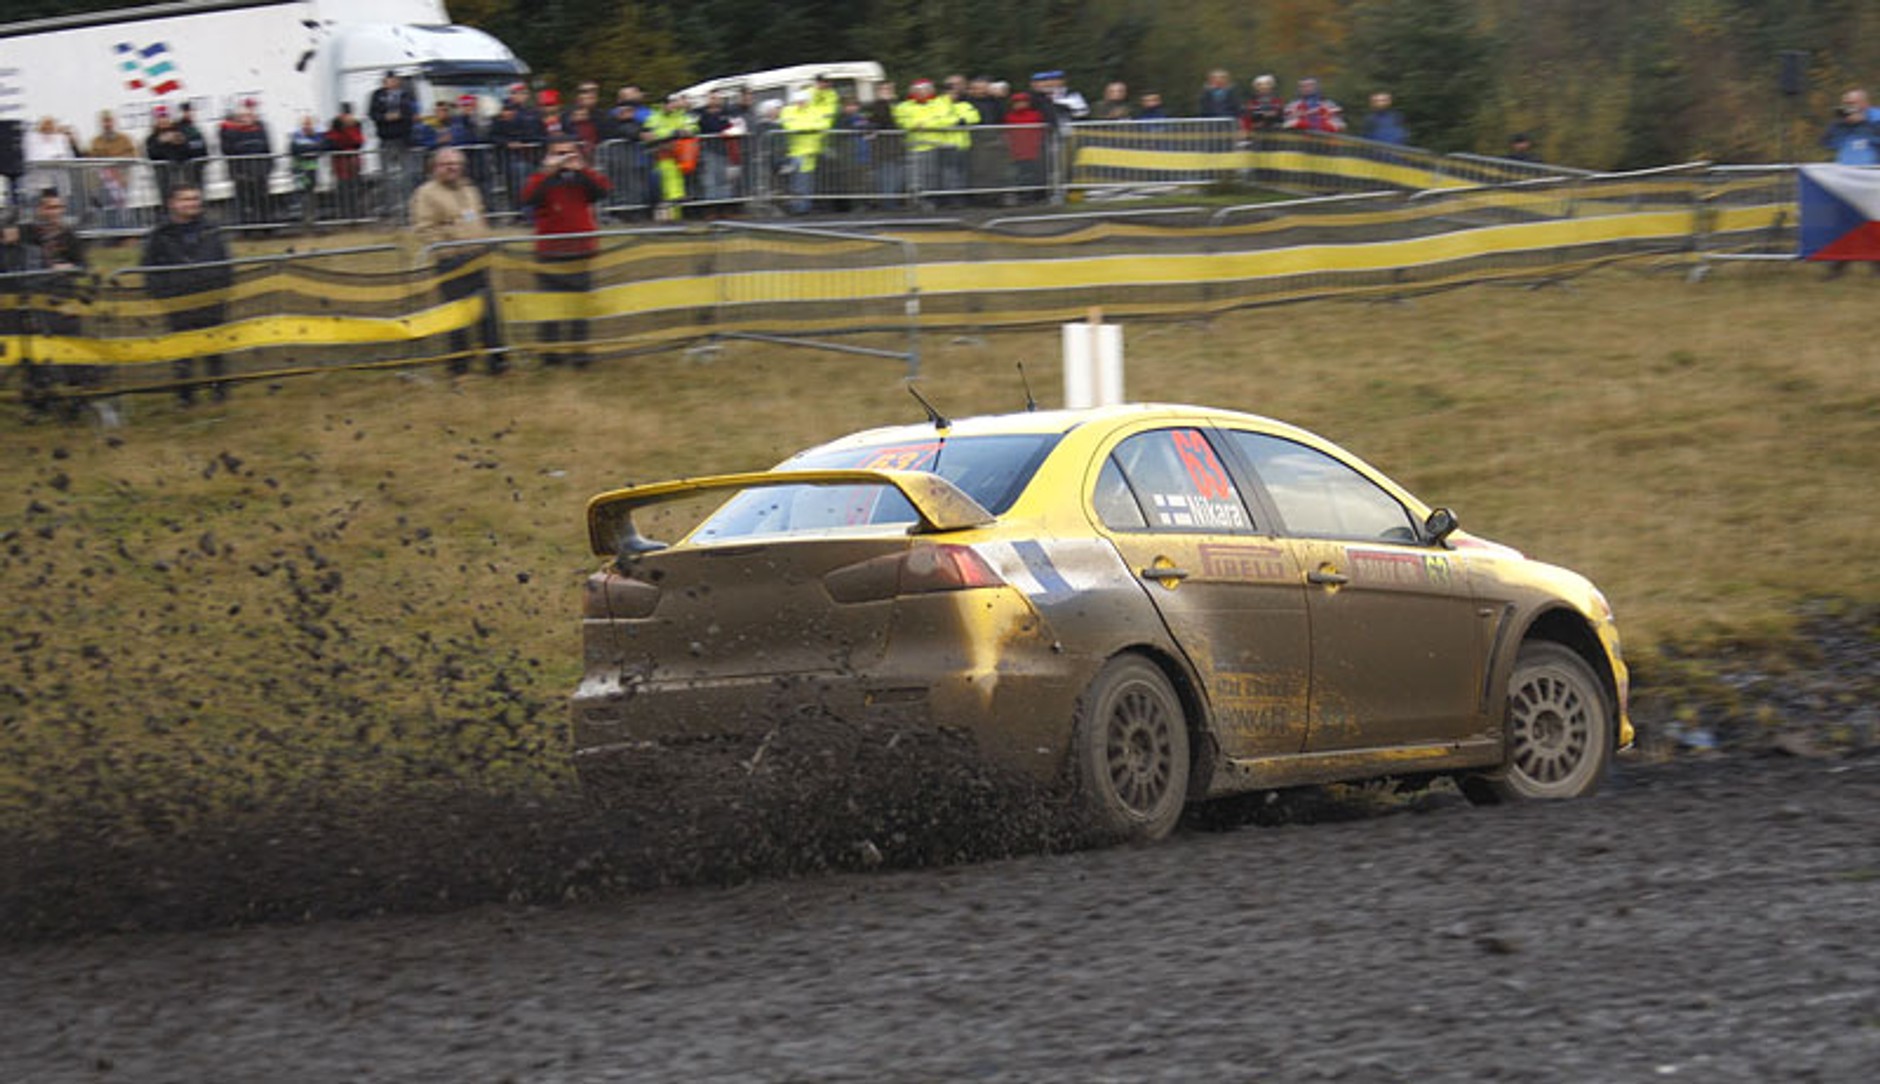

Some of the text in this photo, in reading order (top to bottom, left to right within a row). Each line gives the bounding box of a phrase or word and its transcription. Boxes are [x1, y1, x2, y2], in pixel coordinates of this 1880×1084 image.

[1171, 430, 1230, 501] 63
[1186, 494, 1244, 528] Nikara
[1198, 544, 1285, 580] PIRELLI
